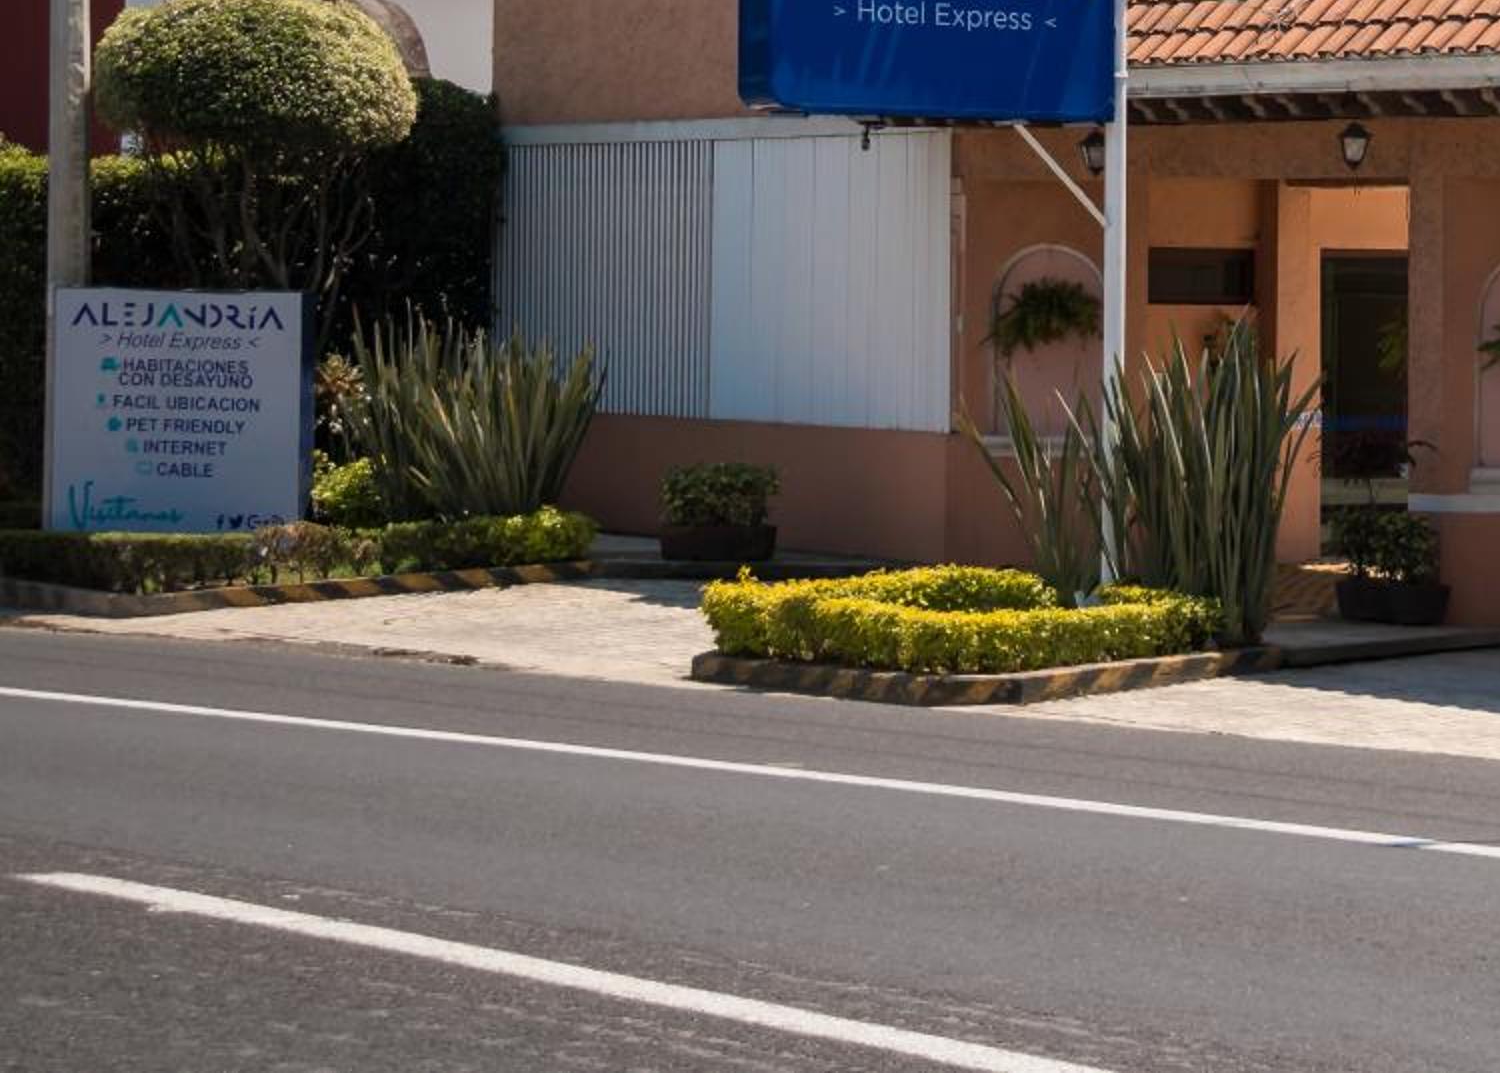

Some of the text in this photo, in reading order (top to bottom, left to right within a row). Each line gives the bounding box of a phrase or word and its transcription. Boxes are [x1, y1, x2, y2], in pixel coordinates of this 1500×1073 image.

[857, 0, 1032, 31] Hotel Express
[117, 332, 241, 351] Hotel Express
[123, 358, 249, 374] HABITACIONES
[118, 373, 253, 390] CON DESAYUNO
[166, 396, 260, 412] UBICACION
[126, 418, 246, 436] PET FRIENDLY
[143, 441, 226, 455] INTERNET
[156, 462, 213, 477] CABLE
